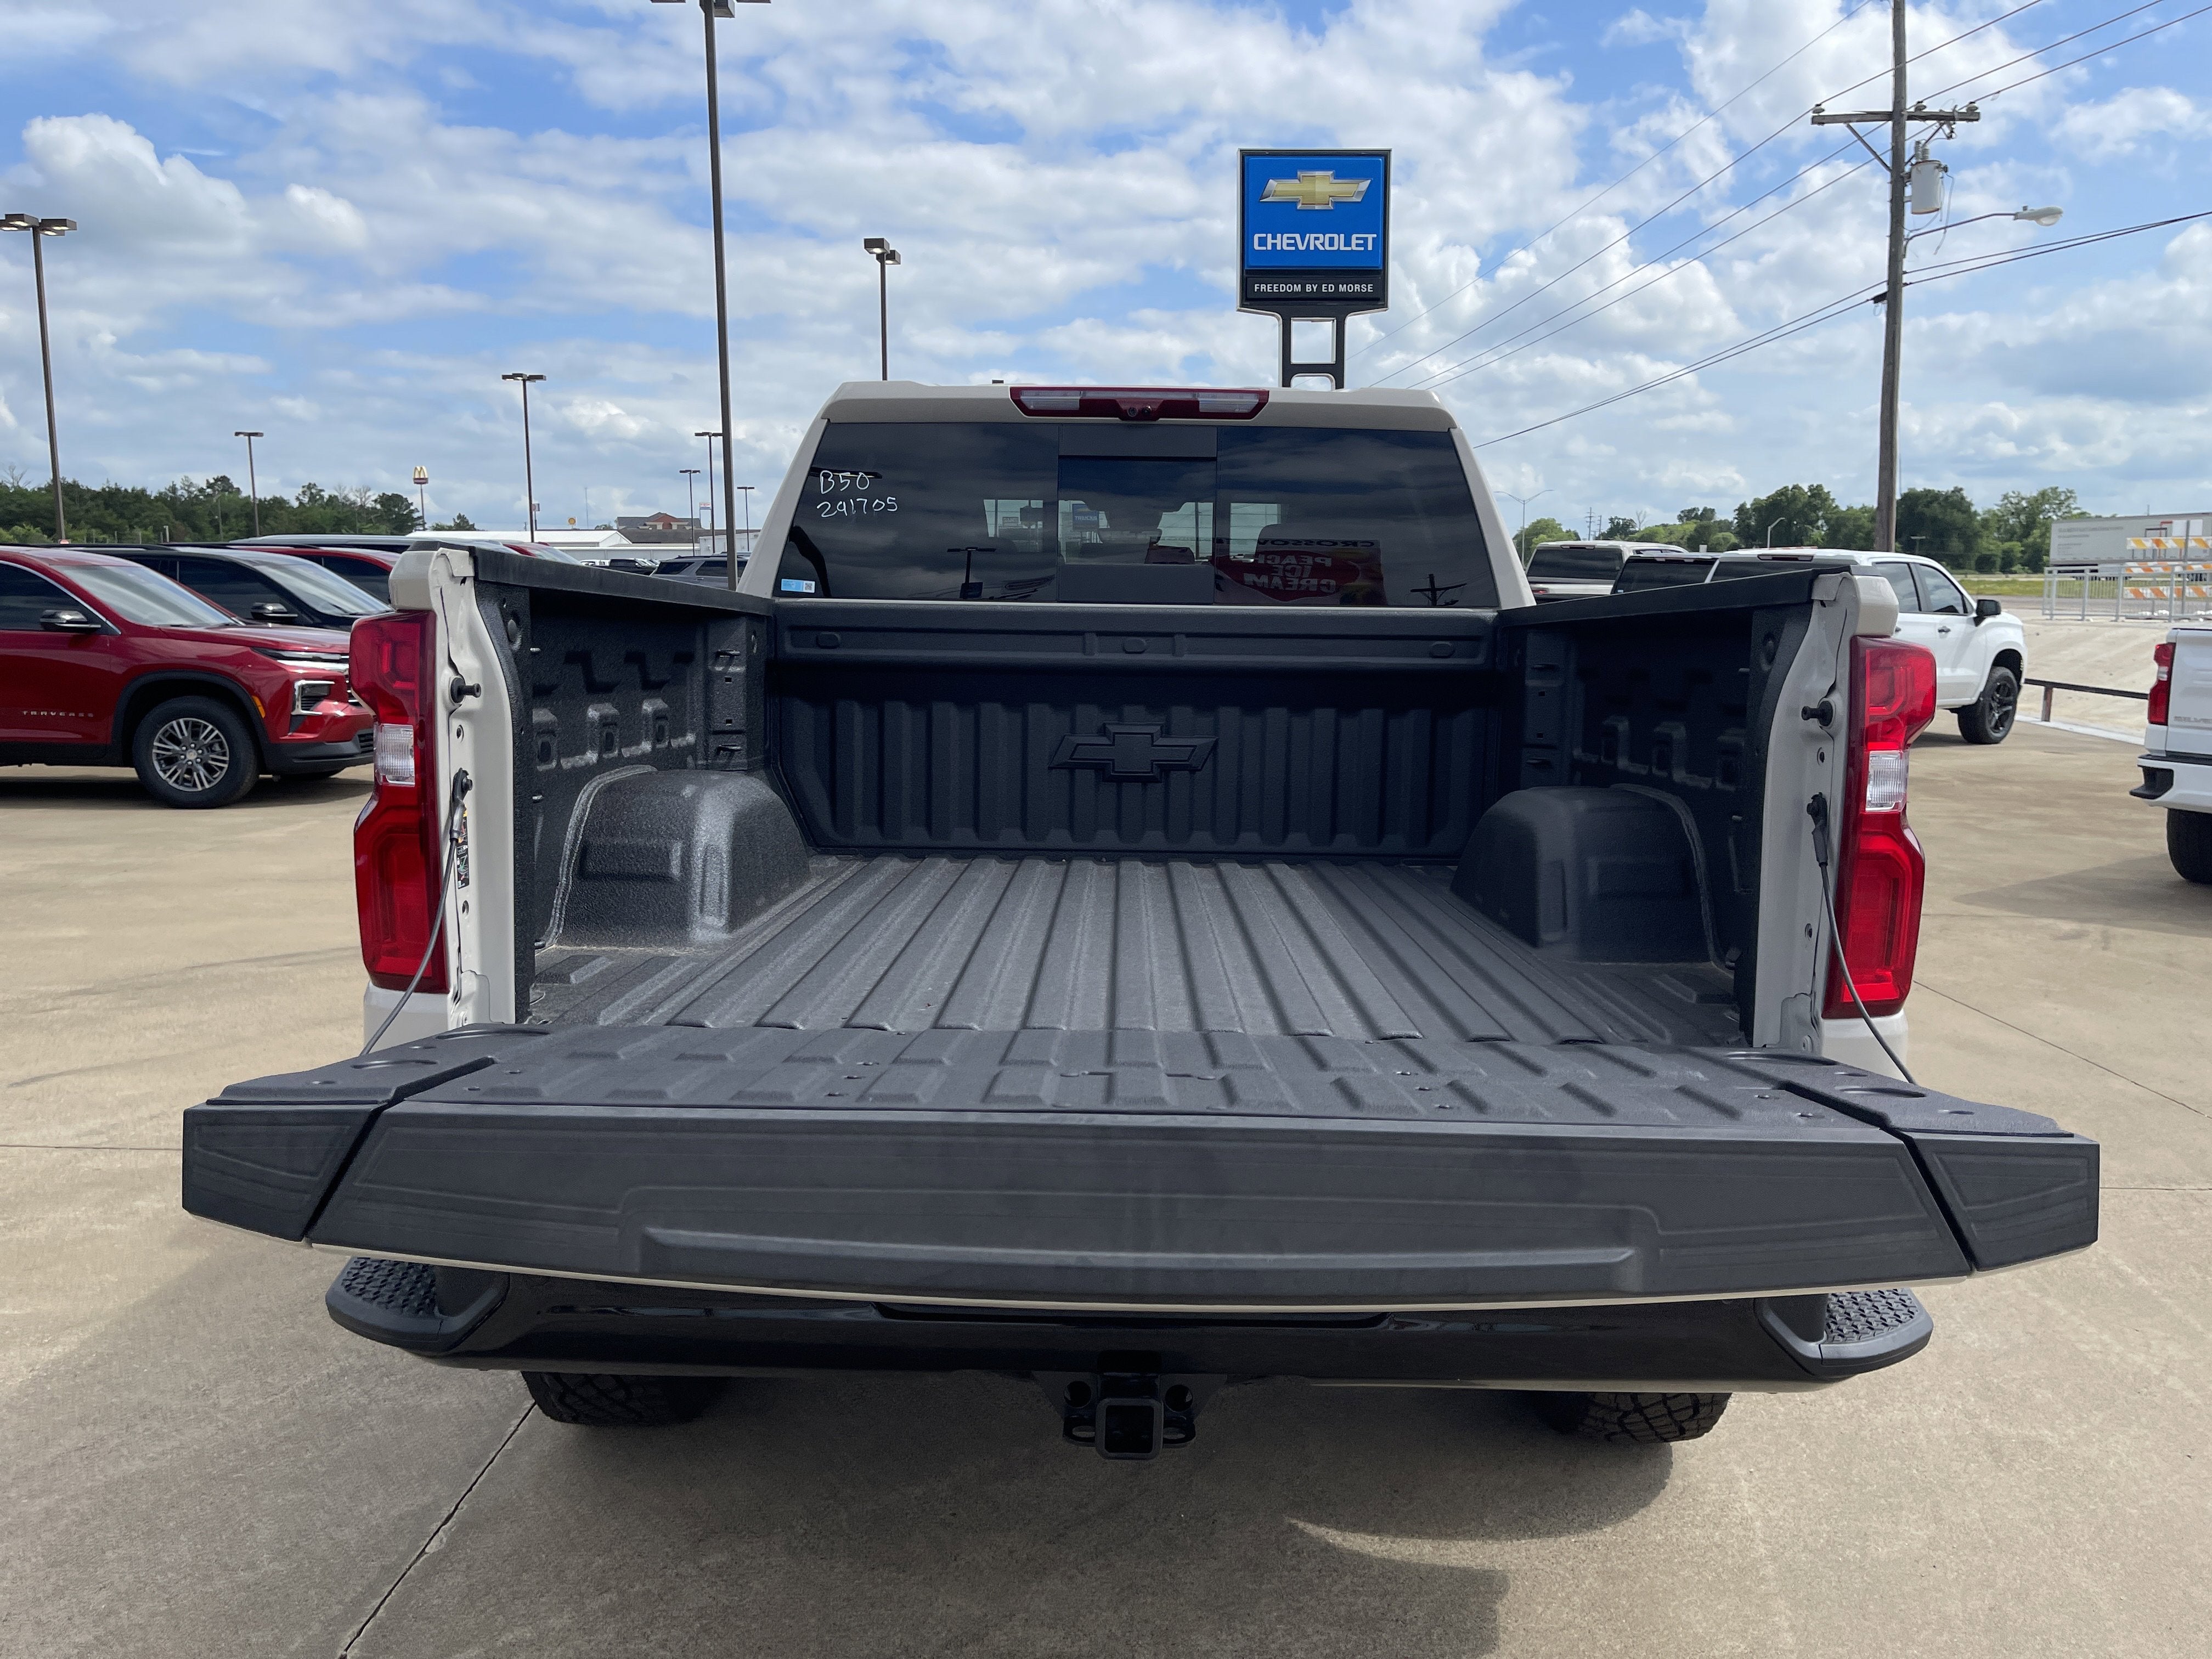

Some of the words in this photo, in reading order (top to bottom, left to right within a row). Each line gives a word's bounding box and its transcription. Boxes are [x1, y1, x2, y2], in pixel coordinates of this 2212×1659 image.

[1254, 233, 1377, 251] CHEVROLET
[1254, 284, 1301, 292] FREEDOM
[1306, 284, 1318, 292] BY
[1322, 284, 1335, 292] ED
[1339, 284, 1374, 292] MORSE
[820, 470, 870, 494] B50
